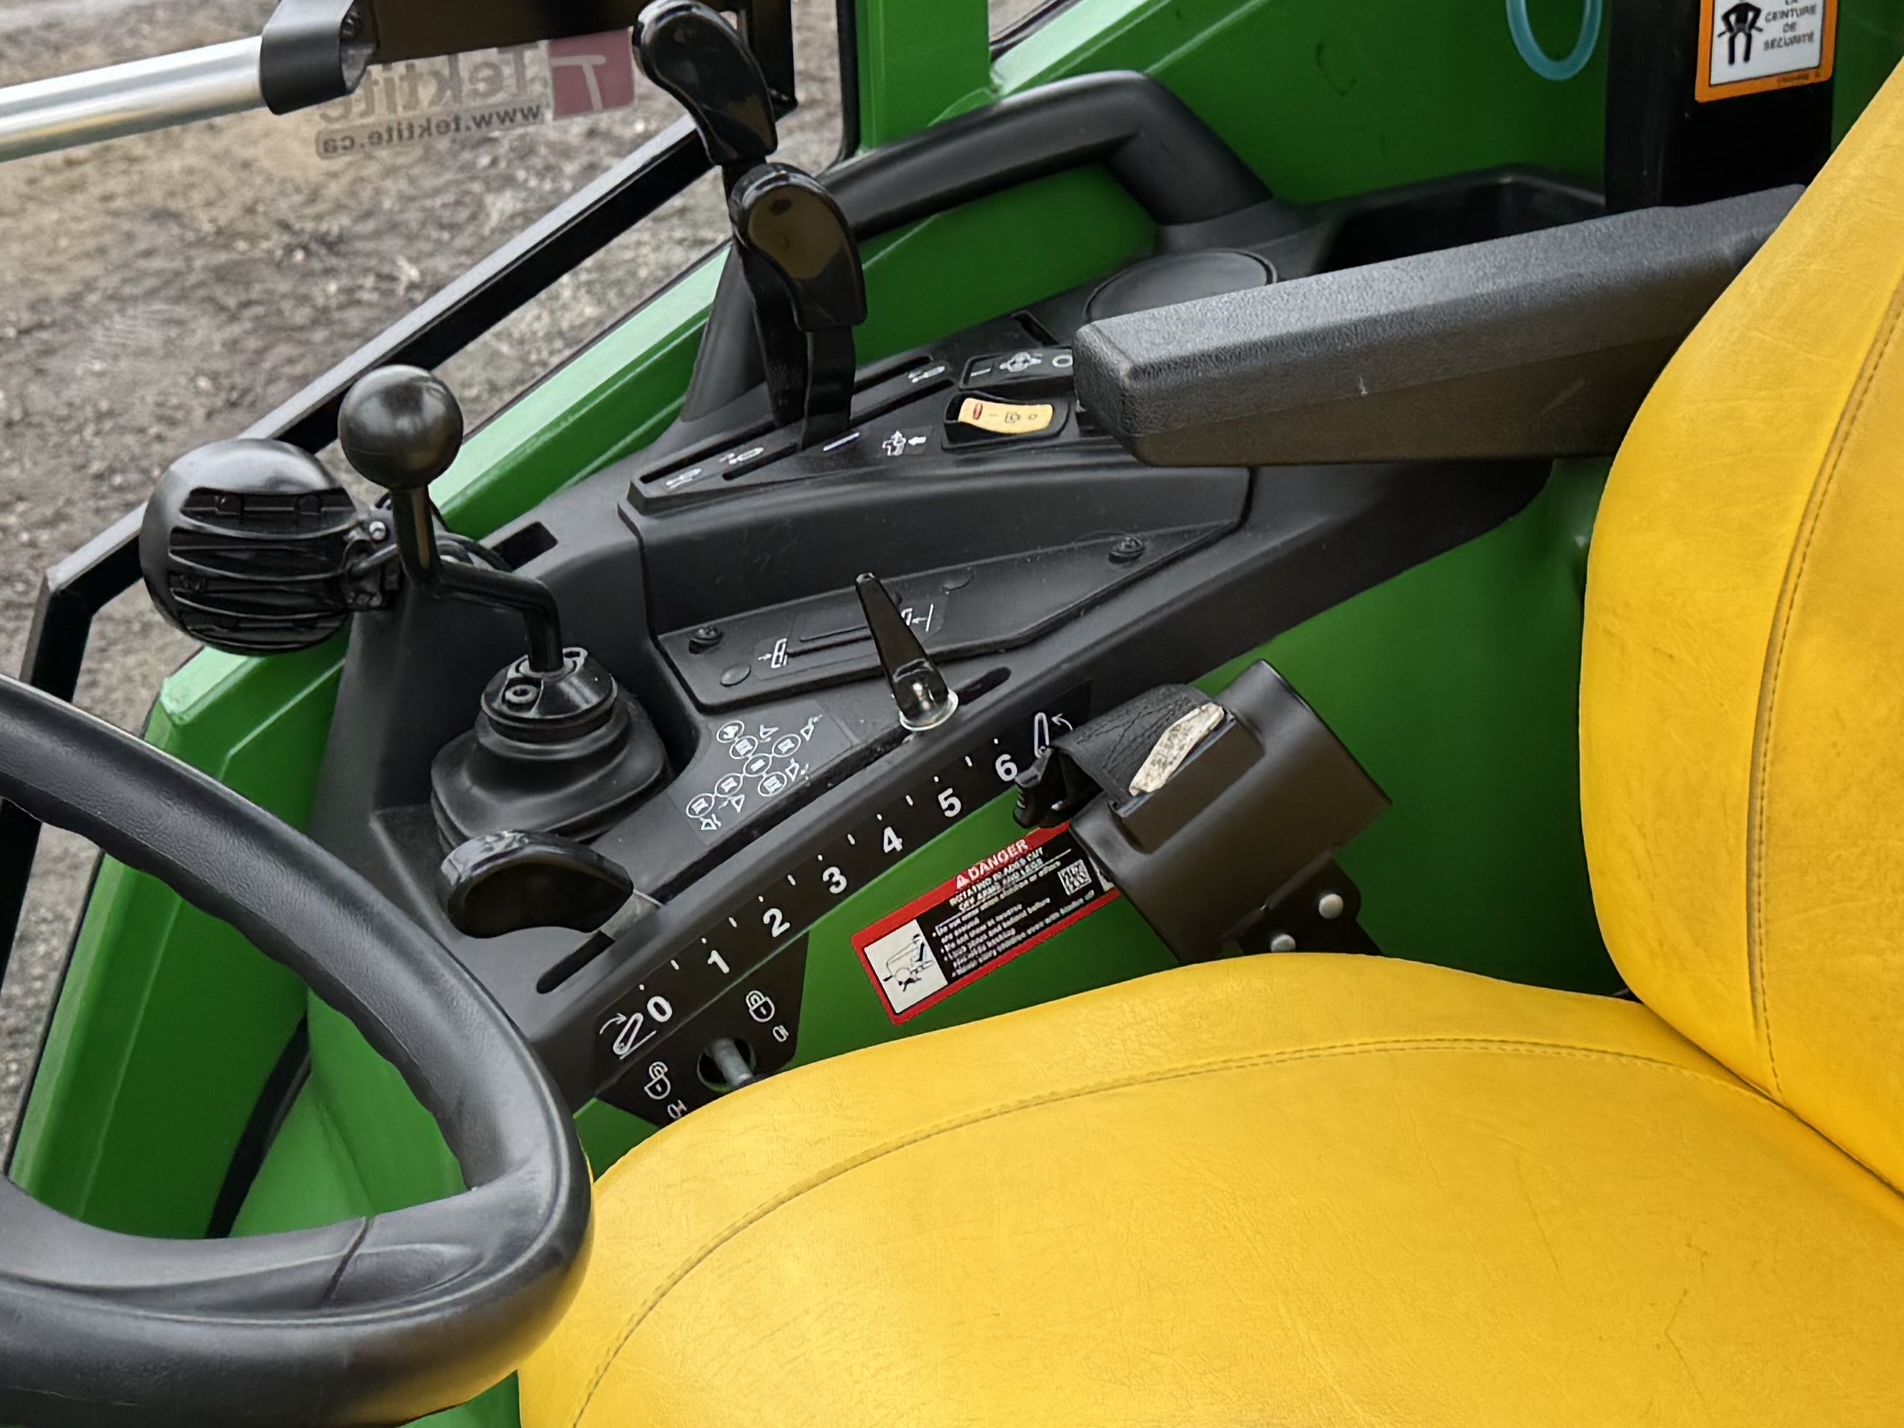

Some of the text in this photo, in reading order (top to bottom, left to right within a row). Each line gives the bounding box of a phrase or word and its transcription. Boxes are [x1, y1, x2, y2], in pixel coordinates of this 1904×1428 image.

[647, 753, 1018, 1023] 0 1 2 3 4 5 6
[968, 839, 1029, 881] DANGER
